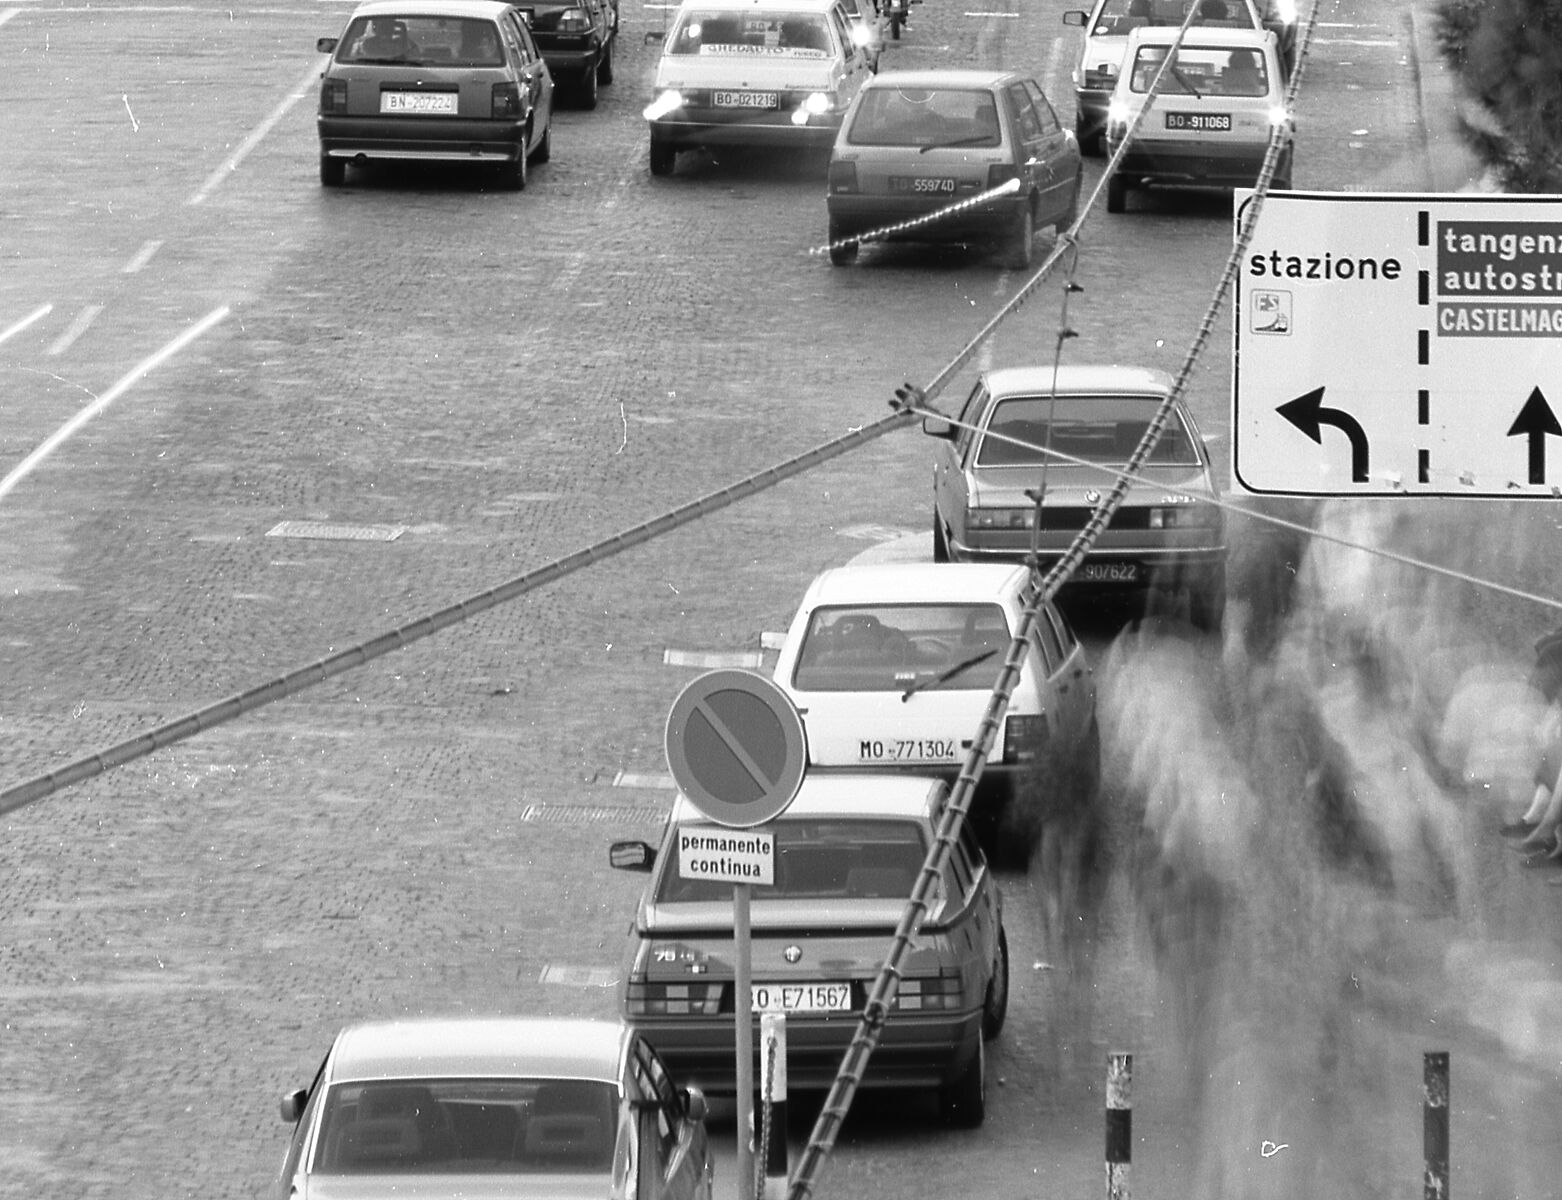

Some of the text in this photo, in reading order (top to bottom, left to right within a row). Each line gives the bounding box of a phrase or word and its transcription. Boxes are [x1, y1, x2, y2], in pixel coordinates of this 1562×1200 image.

[1250, 250, 1402, 280] stazione
[1440, 308, 1562, 332] CASTELMAG
[681, 835, 771, 855] permanente
[690, 858, 761, 877] continua
